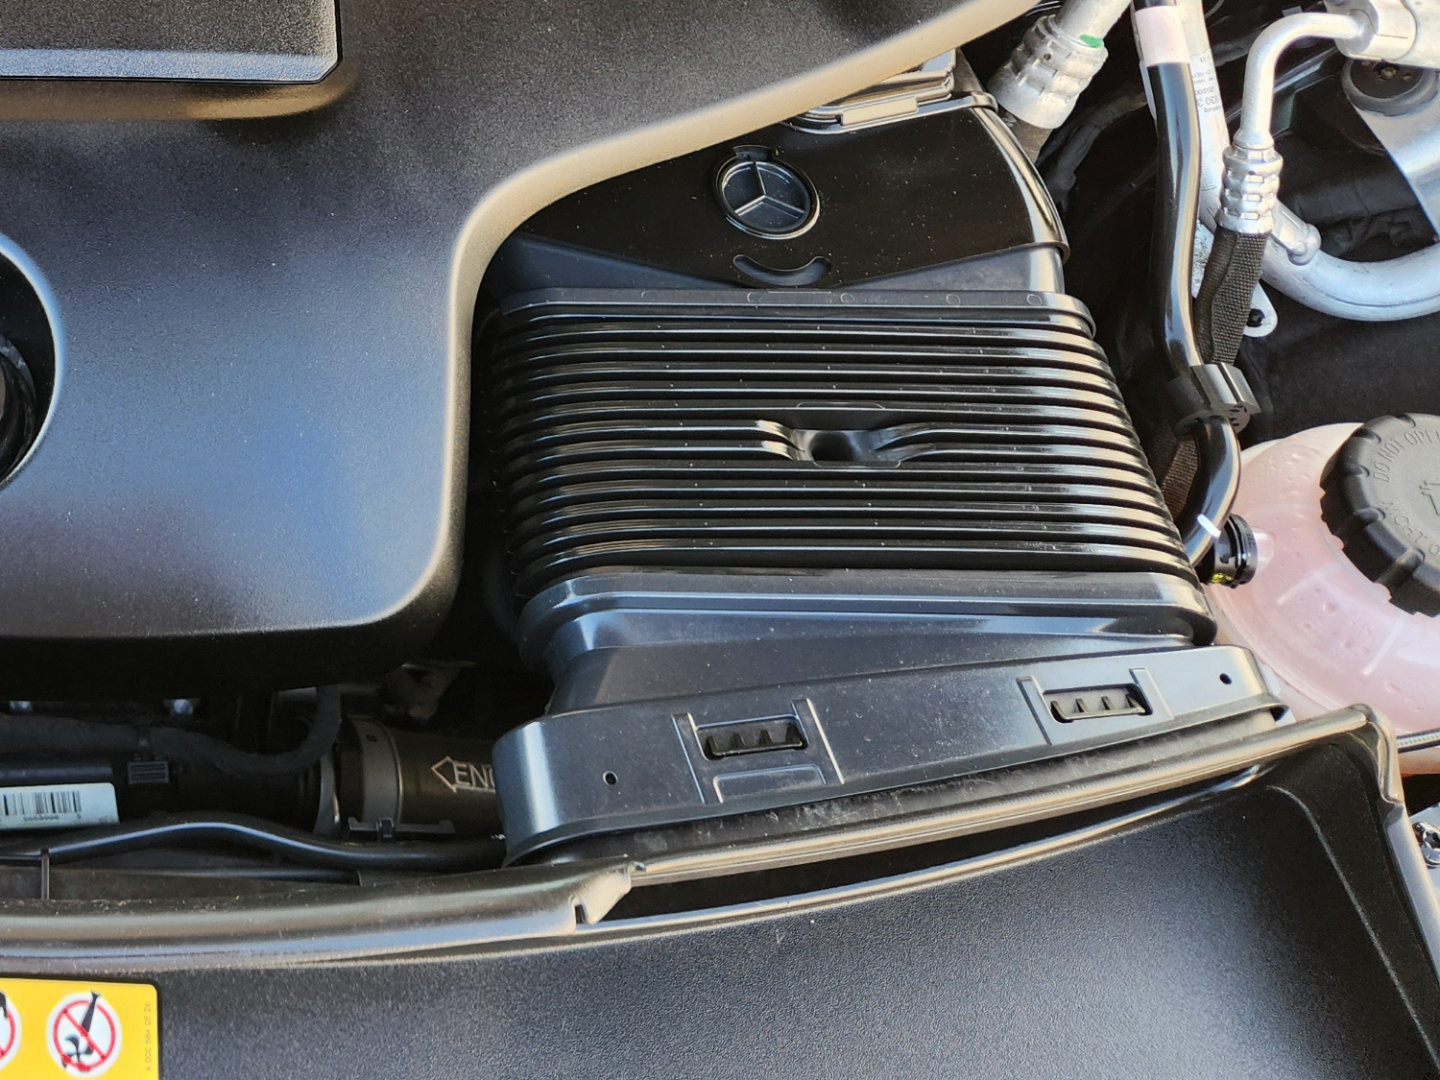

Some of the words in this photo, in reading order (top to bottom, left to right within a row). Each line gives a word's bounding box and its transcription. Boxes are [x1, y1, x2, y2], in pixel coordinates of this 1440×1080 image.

[1403, 428, 1440, 446] OPE
[1377, 438, 1405, 462] NOT
[1374, 461, 1391, 483] DO
